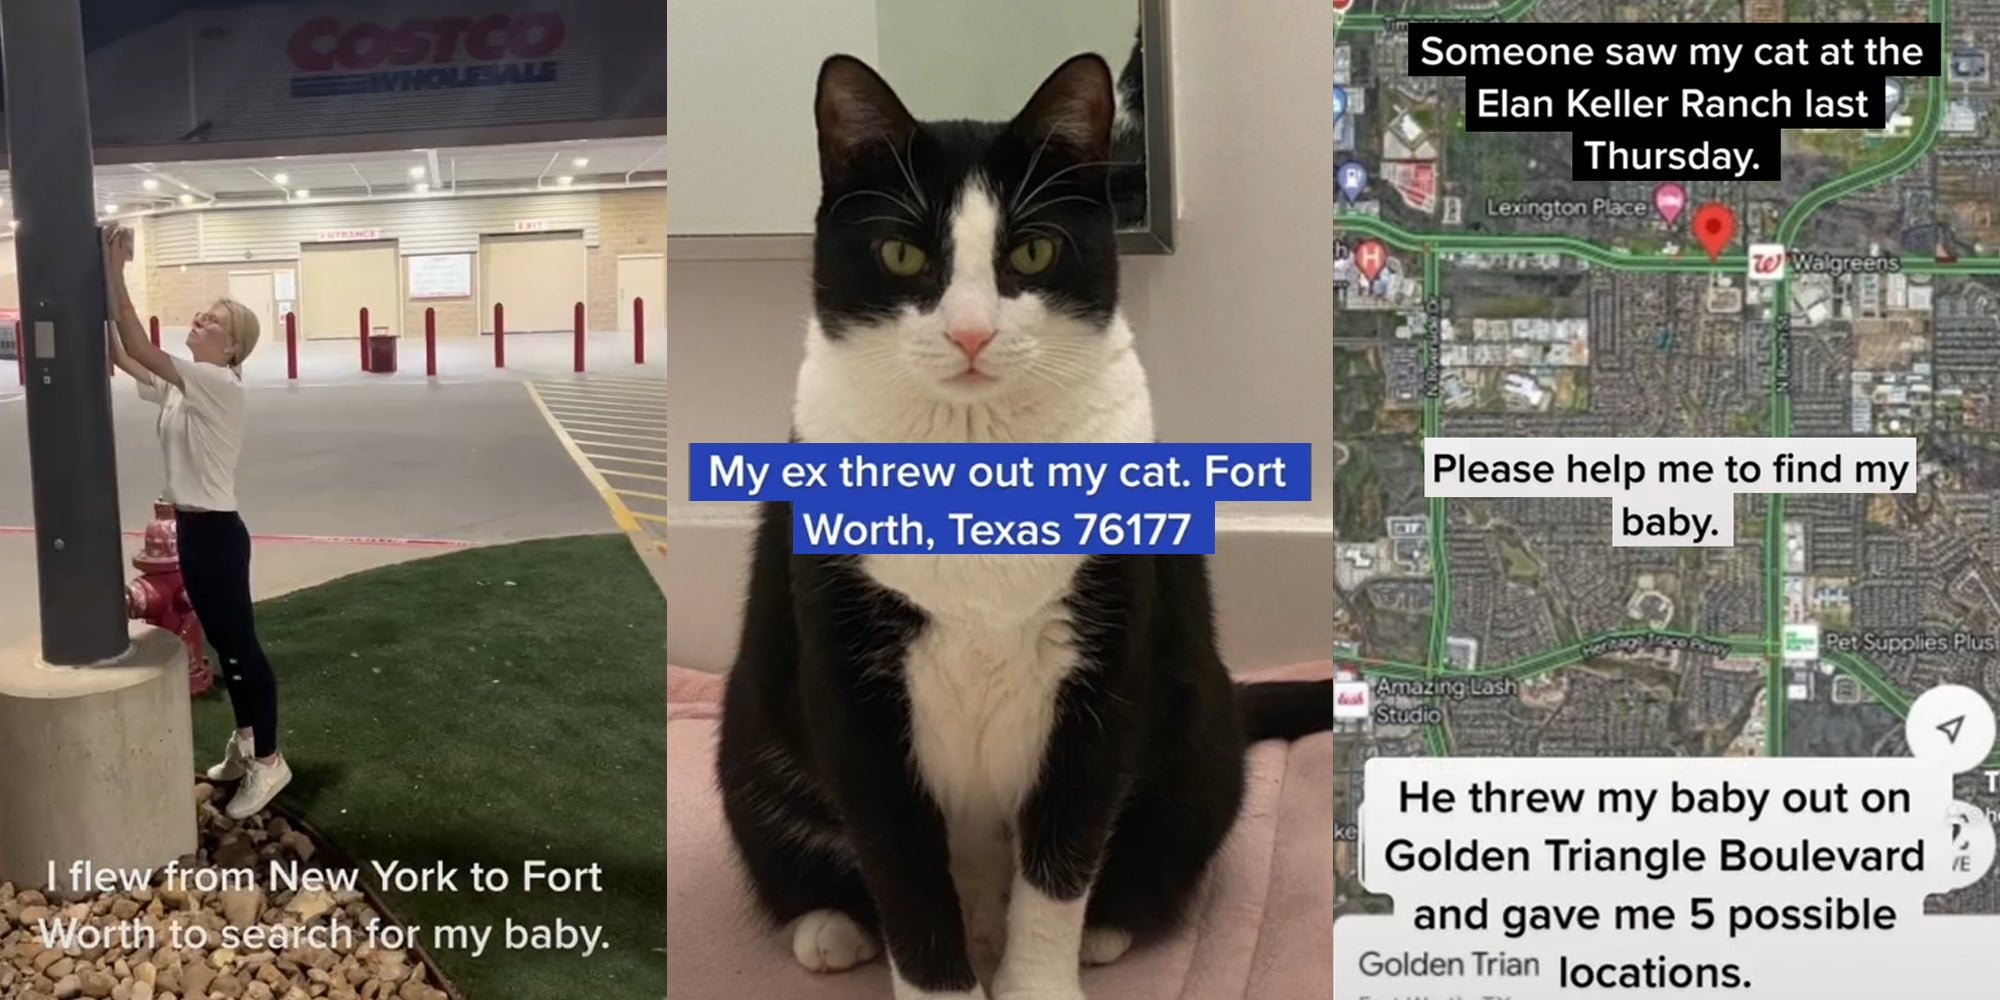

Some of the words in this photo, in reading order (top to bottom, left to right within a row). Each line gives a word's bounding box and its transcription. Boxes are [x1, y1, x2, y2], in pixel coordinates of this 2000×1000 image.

[288, 11, 567, 72] COSTCO
[1487, 198, 1587, 221] Lexington
[1593, 198, 1648, 216] Place
[320, 230, 377, 240] ENTRANCE
[1792, 252, 1899, 273] Walgreens
[1826, 633, 1858, 650] Pet
[1863, 633, 1948, 654] Supplies
[1954, 633, 1995, 650] Plus
[1377, 678, 1466, 699] Amazing
[1471, 678, 1518, 695] Lash
[1377, 705, 1442, 723] Studio
[1358, 950, 1464, 977] Golden
[1471, 950, 1540, 977] Trian
